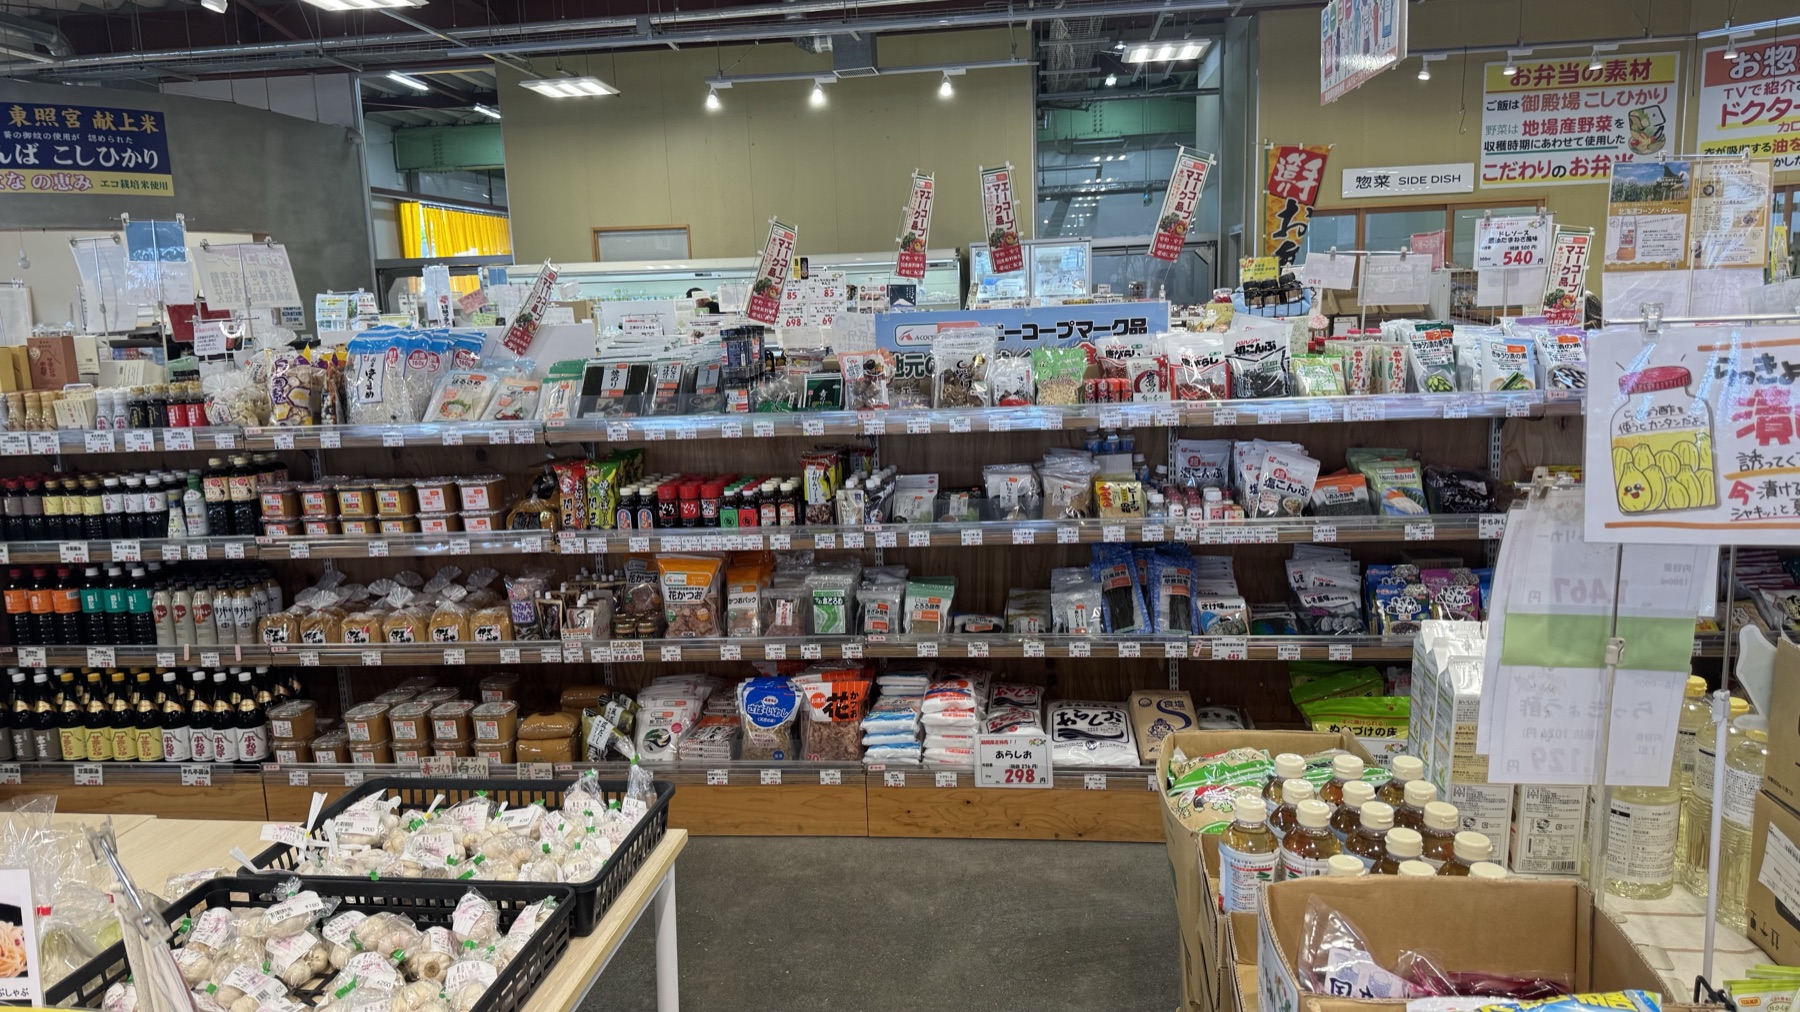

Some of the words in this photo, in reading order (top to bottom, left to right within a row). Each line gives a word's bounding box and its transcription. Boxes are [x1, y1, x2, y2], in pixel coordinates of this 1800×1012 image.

[1729, 44, 1800, 79] お惣
[1510, 58, 1652, 87] お弁当の素材
[8, 105, 82, 128] 東照宮
[93, 110, 159, 134] 献上米
[1484, 134, 1625, 152] 収穫時期にあわせて使用した
[53, 145, 159, 170] こしひかり
[1355, 174, 1390, 189] 惣菜
[1399, 175, 1428, 186] SIDE
[1431, 174, 1461, 184] DISH
[1503, 250, 1533, 266] 540
[1558, 245, 1575, 287] マーク品
[787, 292, 797, 300] 85
[824, 289, 834, 297] 85
[786, 319, 801, 327] 698
[669, 591, 703, 601] 花かつお
[822, 691, 850, 720] 花
[1164, 699, 1185, 708] 食塩
[1057, 709, 1122, 727] あらしお
[995, 750, 1032, 759] あらしお
[1005, 769, 1035, 783] 298
